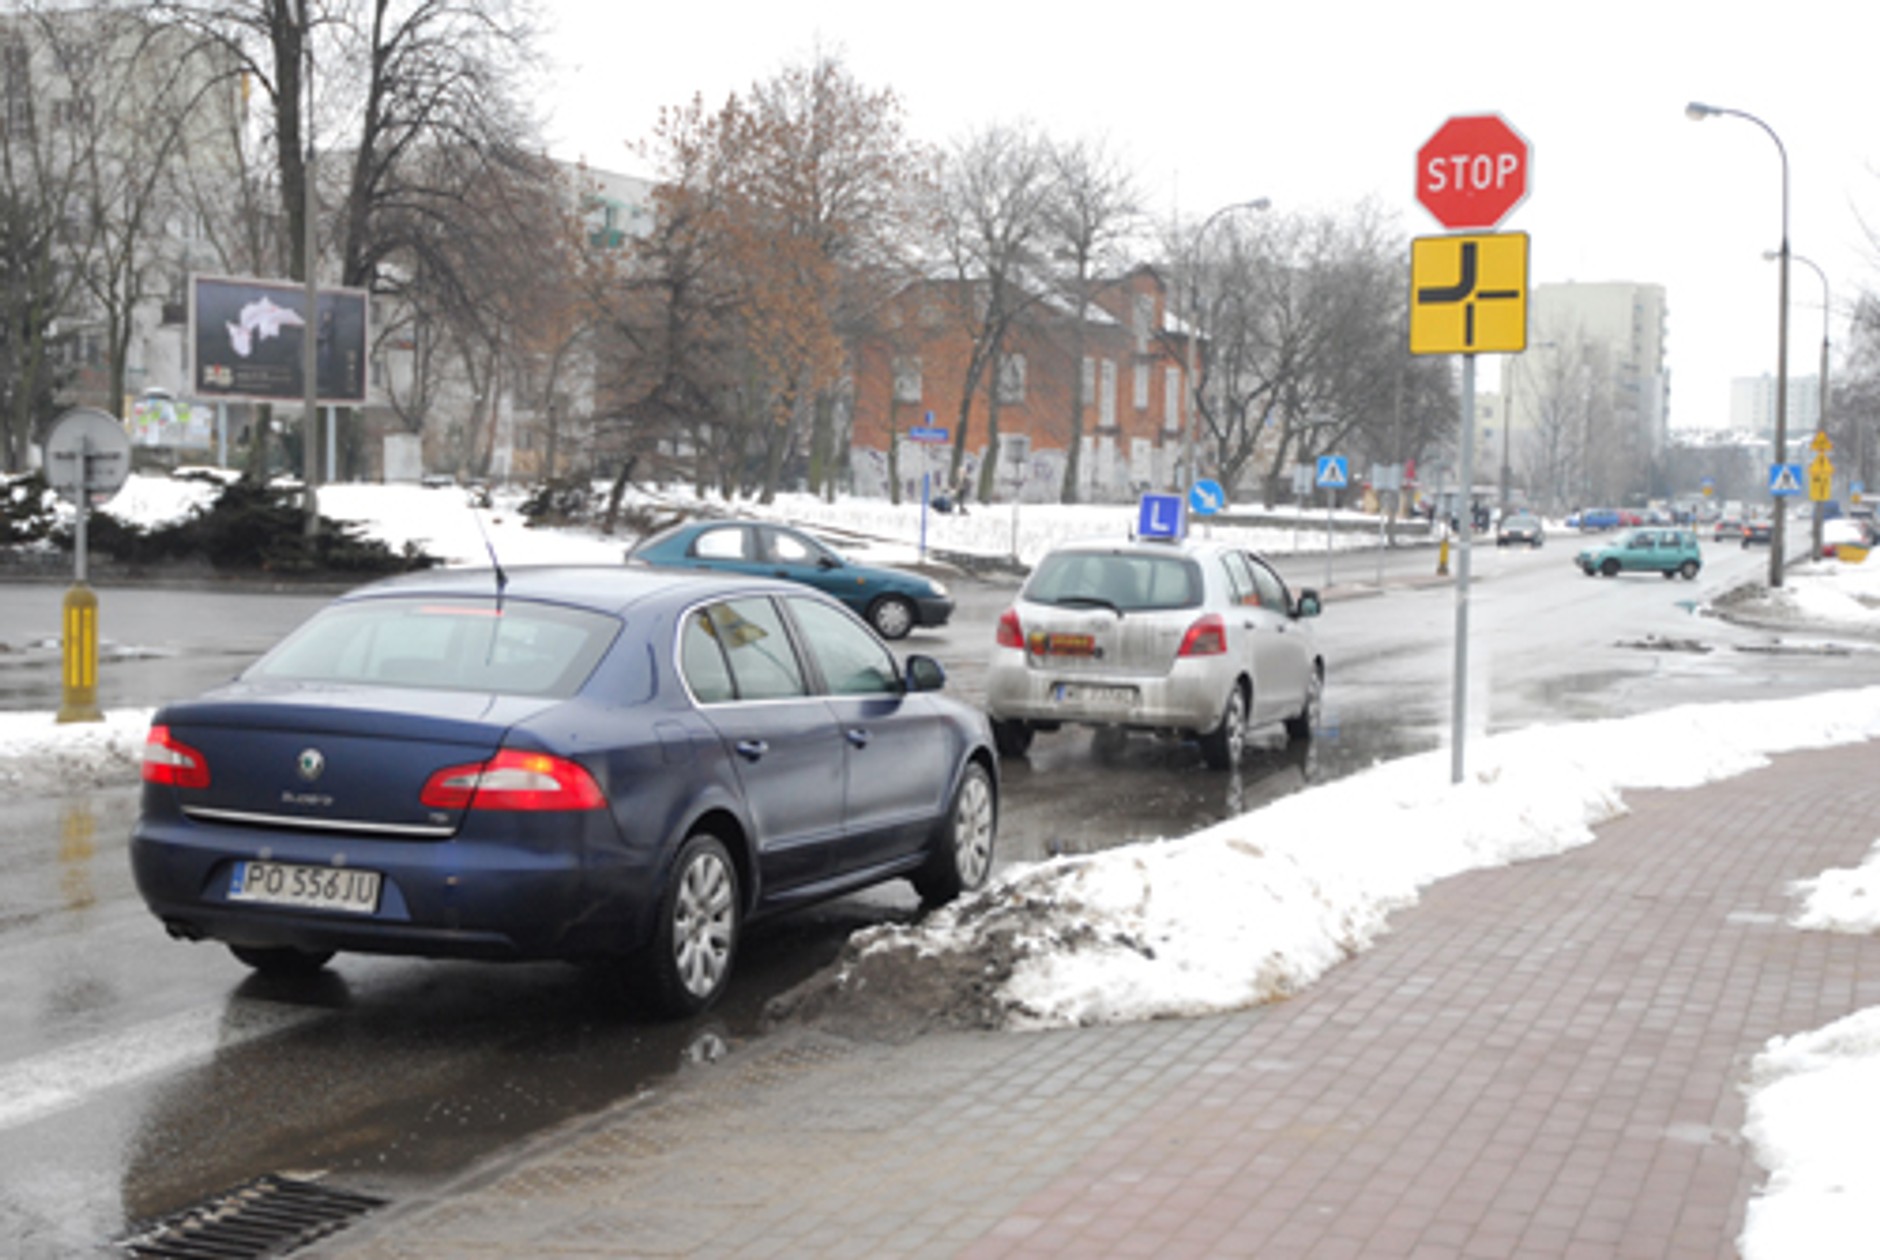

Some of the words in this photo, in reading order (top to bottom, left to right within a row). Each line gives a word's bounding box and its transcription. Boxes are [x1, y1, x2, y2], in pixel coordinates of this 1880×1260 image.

[1428, 154, 1518, 192] STOP
[1150, 500, 1170, 532] L
[246, 864, 284, 894] PO
[292, 867, 374, 903] 556JU
